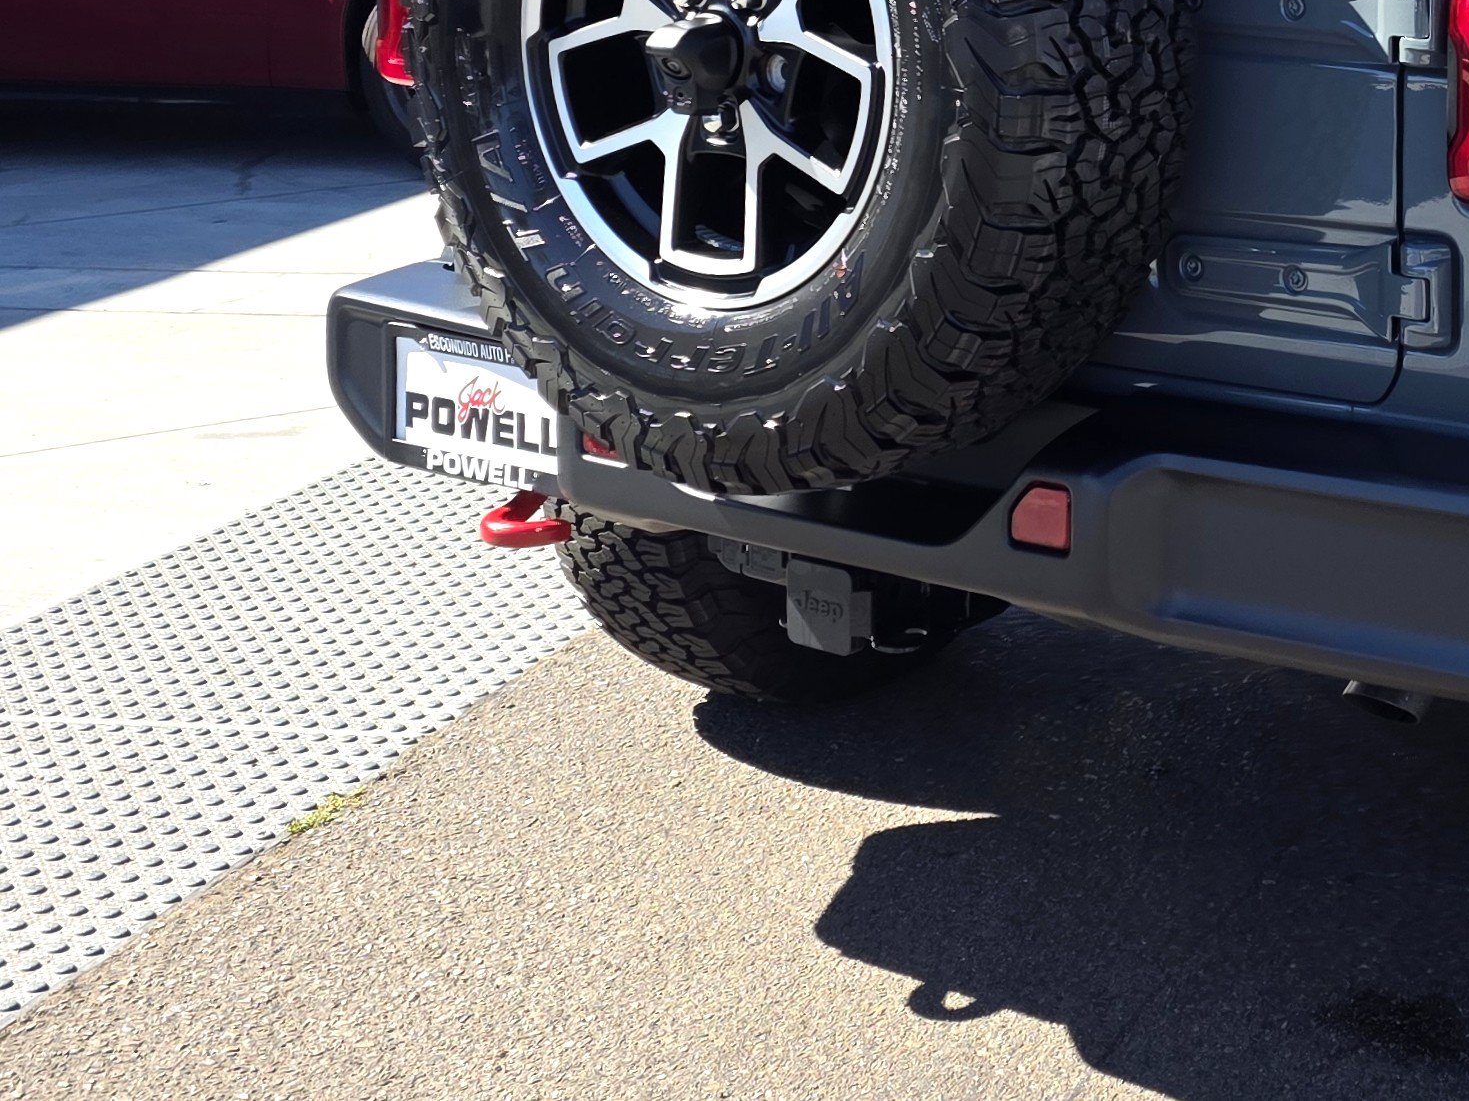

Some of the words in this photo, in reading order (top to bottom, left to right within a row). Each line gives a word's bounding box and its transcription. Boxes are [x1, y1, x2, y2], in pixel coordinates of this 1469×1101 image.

[428, 333, 479, 357] ESCONDIDO
[480, 343, 504, 362] AUTO
[457, 375, 505, 423] Jack
[405, 391, 558, 455] POWELL
[426, 448, 534, 491] POWELL
[794, 590, 844, 624] Jeep
